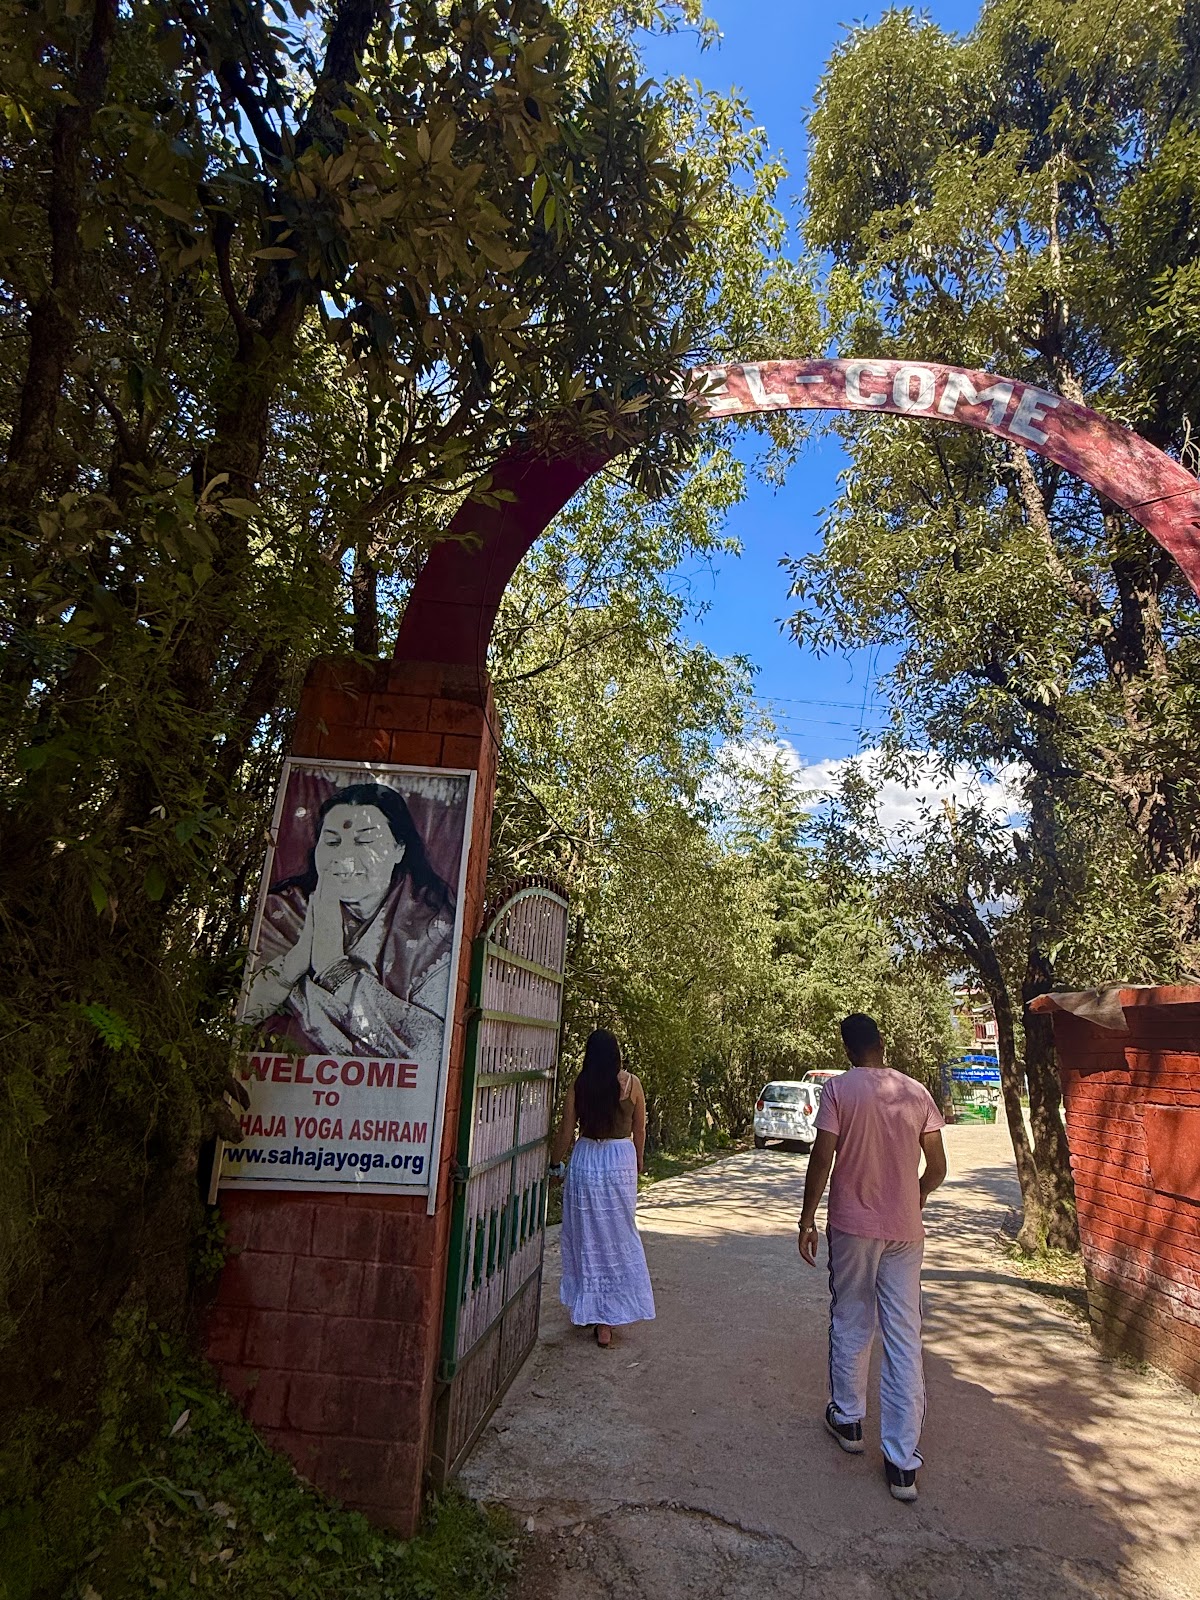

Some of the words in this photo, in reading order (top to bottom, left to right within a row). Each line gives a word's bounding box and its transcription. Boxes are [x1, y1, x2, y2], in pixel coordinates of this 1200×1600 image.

[240, 1056, 419, 1089] WELCOME
[312, 1090, 340, 1107] TO
[240, 1114, 287, 1138] HAJA
[294, 1116, 343, 1140] YOGA
[349, 1119, 428, 1144] ASHRAM
[222, 1146, 425, 1175] ww.sahajayoga.org
